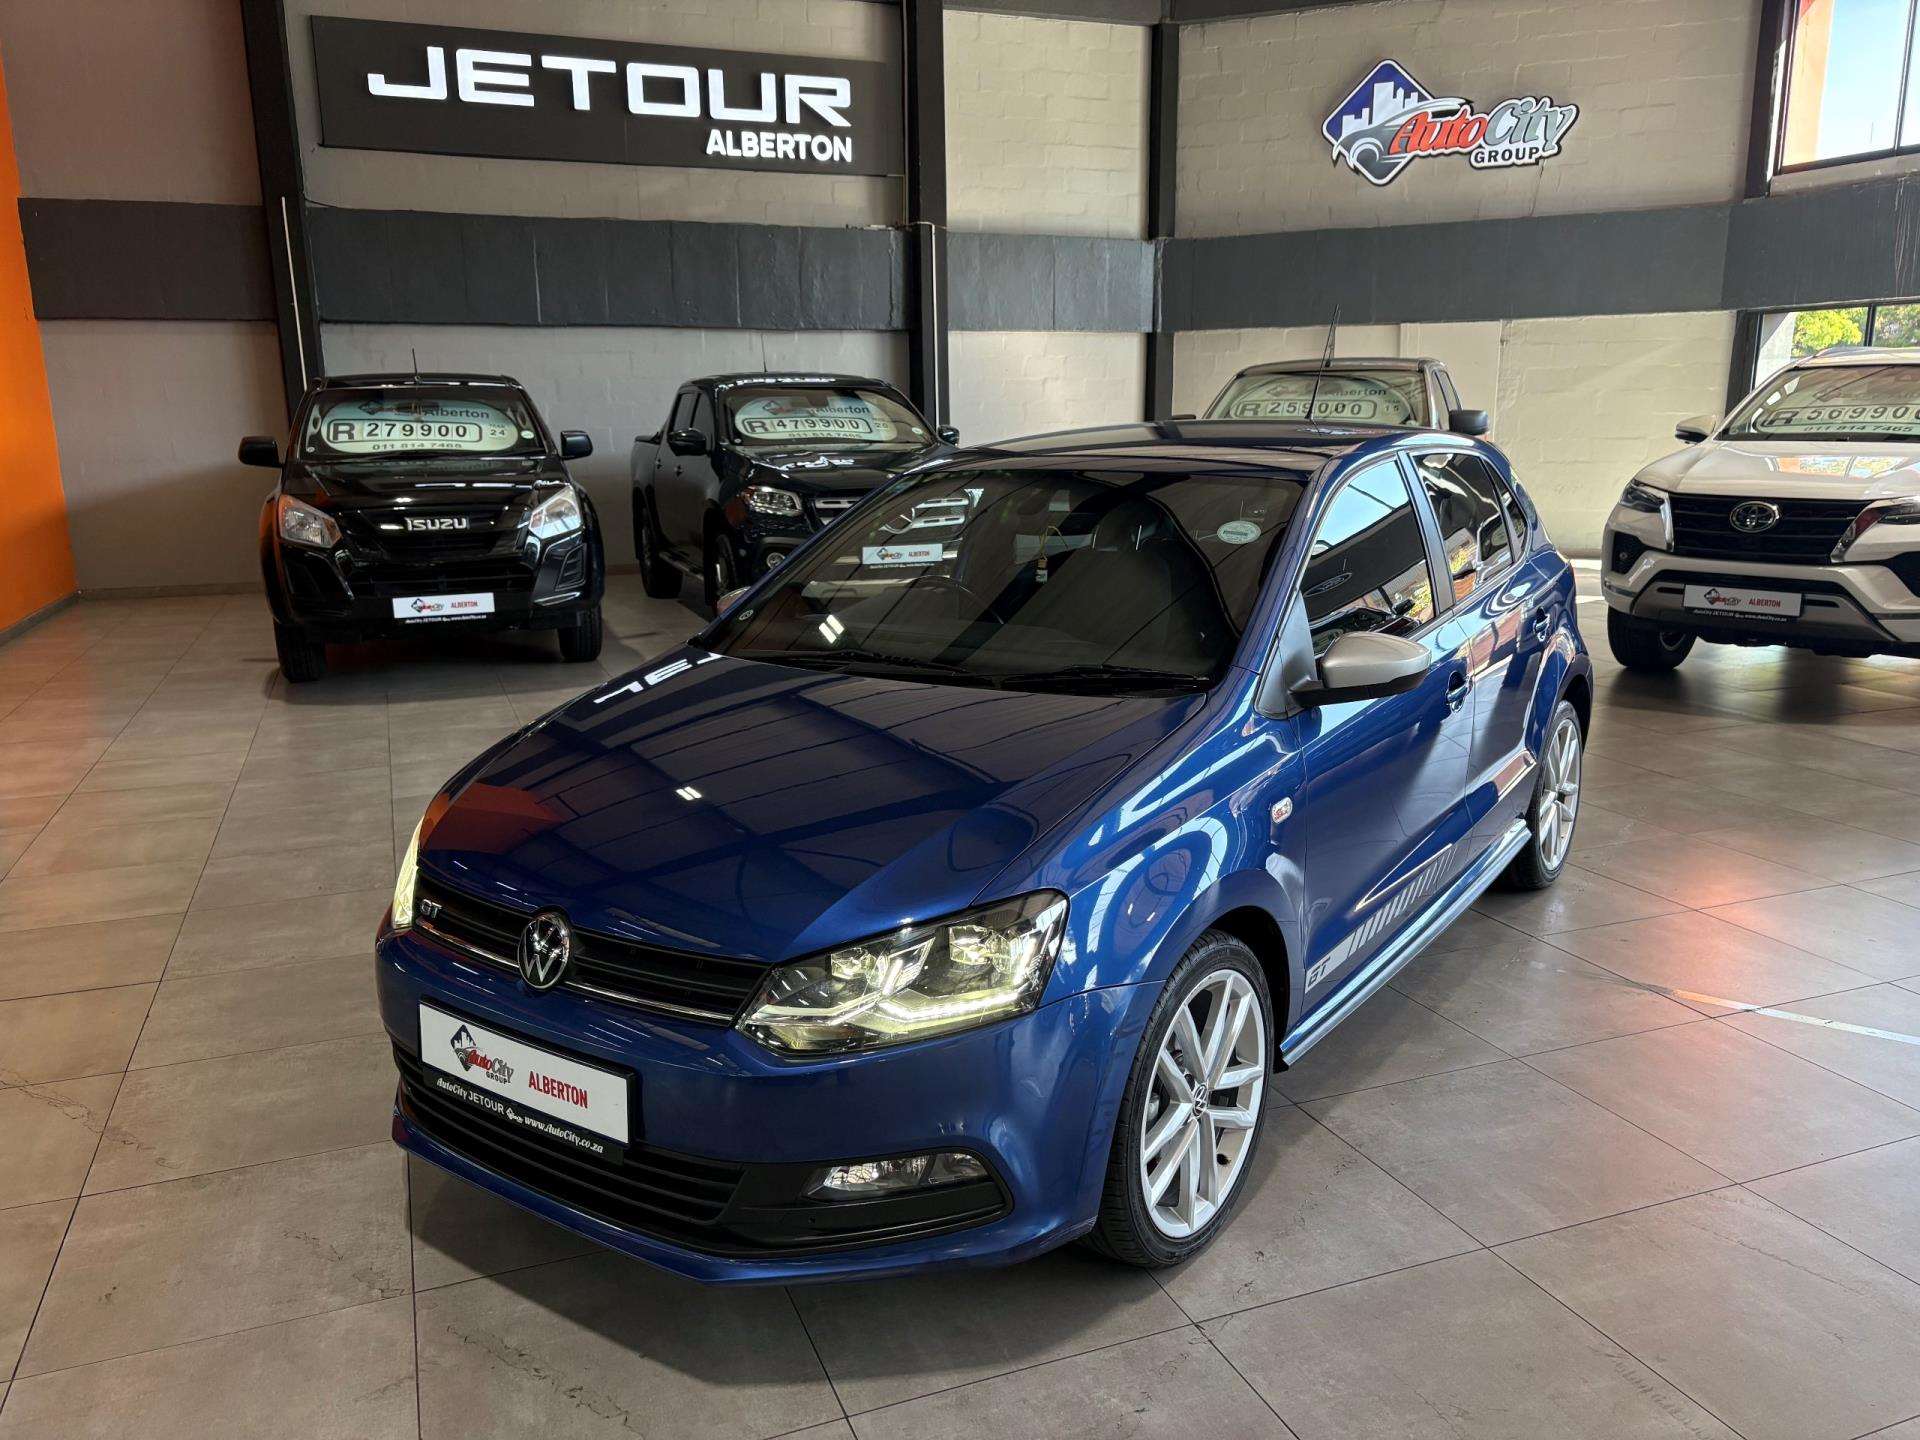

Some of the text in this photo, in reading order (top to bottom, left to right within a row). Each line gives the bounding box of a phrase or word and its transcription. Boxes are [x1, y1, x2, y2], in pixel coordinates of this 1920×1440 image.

[367, 46, 852, 127] JETOUR
[1389, 100, 1575, 154] AutoCity
[706, 129, 852, 162] ALBERTON
[1474, 147, 1539, 164] GROUP
[424, 407, 490, 419] Alberton
[332, 422, 468, 441] R 279900
[746, 418, 860, 433] R 479900
[404, 517, 469, 531] ISUZU
[1749, 597, 1781, 608] ALBERTON
[420, 899, 443, 919] GT
[1308, 956, 1330, 987] GT
[466, 1049, 515, 1083] AutoCity
[486, 1071, 508, 1085] GROUP
[528, 1071, 589, 1109] ALBERTON
[436, 1077, 604, 1153] AutoCity JETOUR www.AutoCity.co.za
